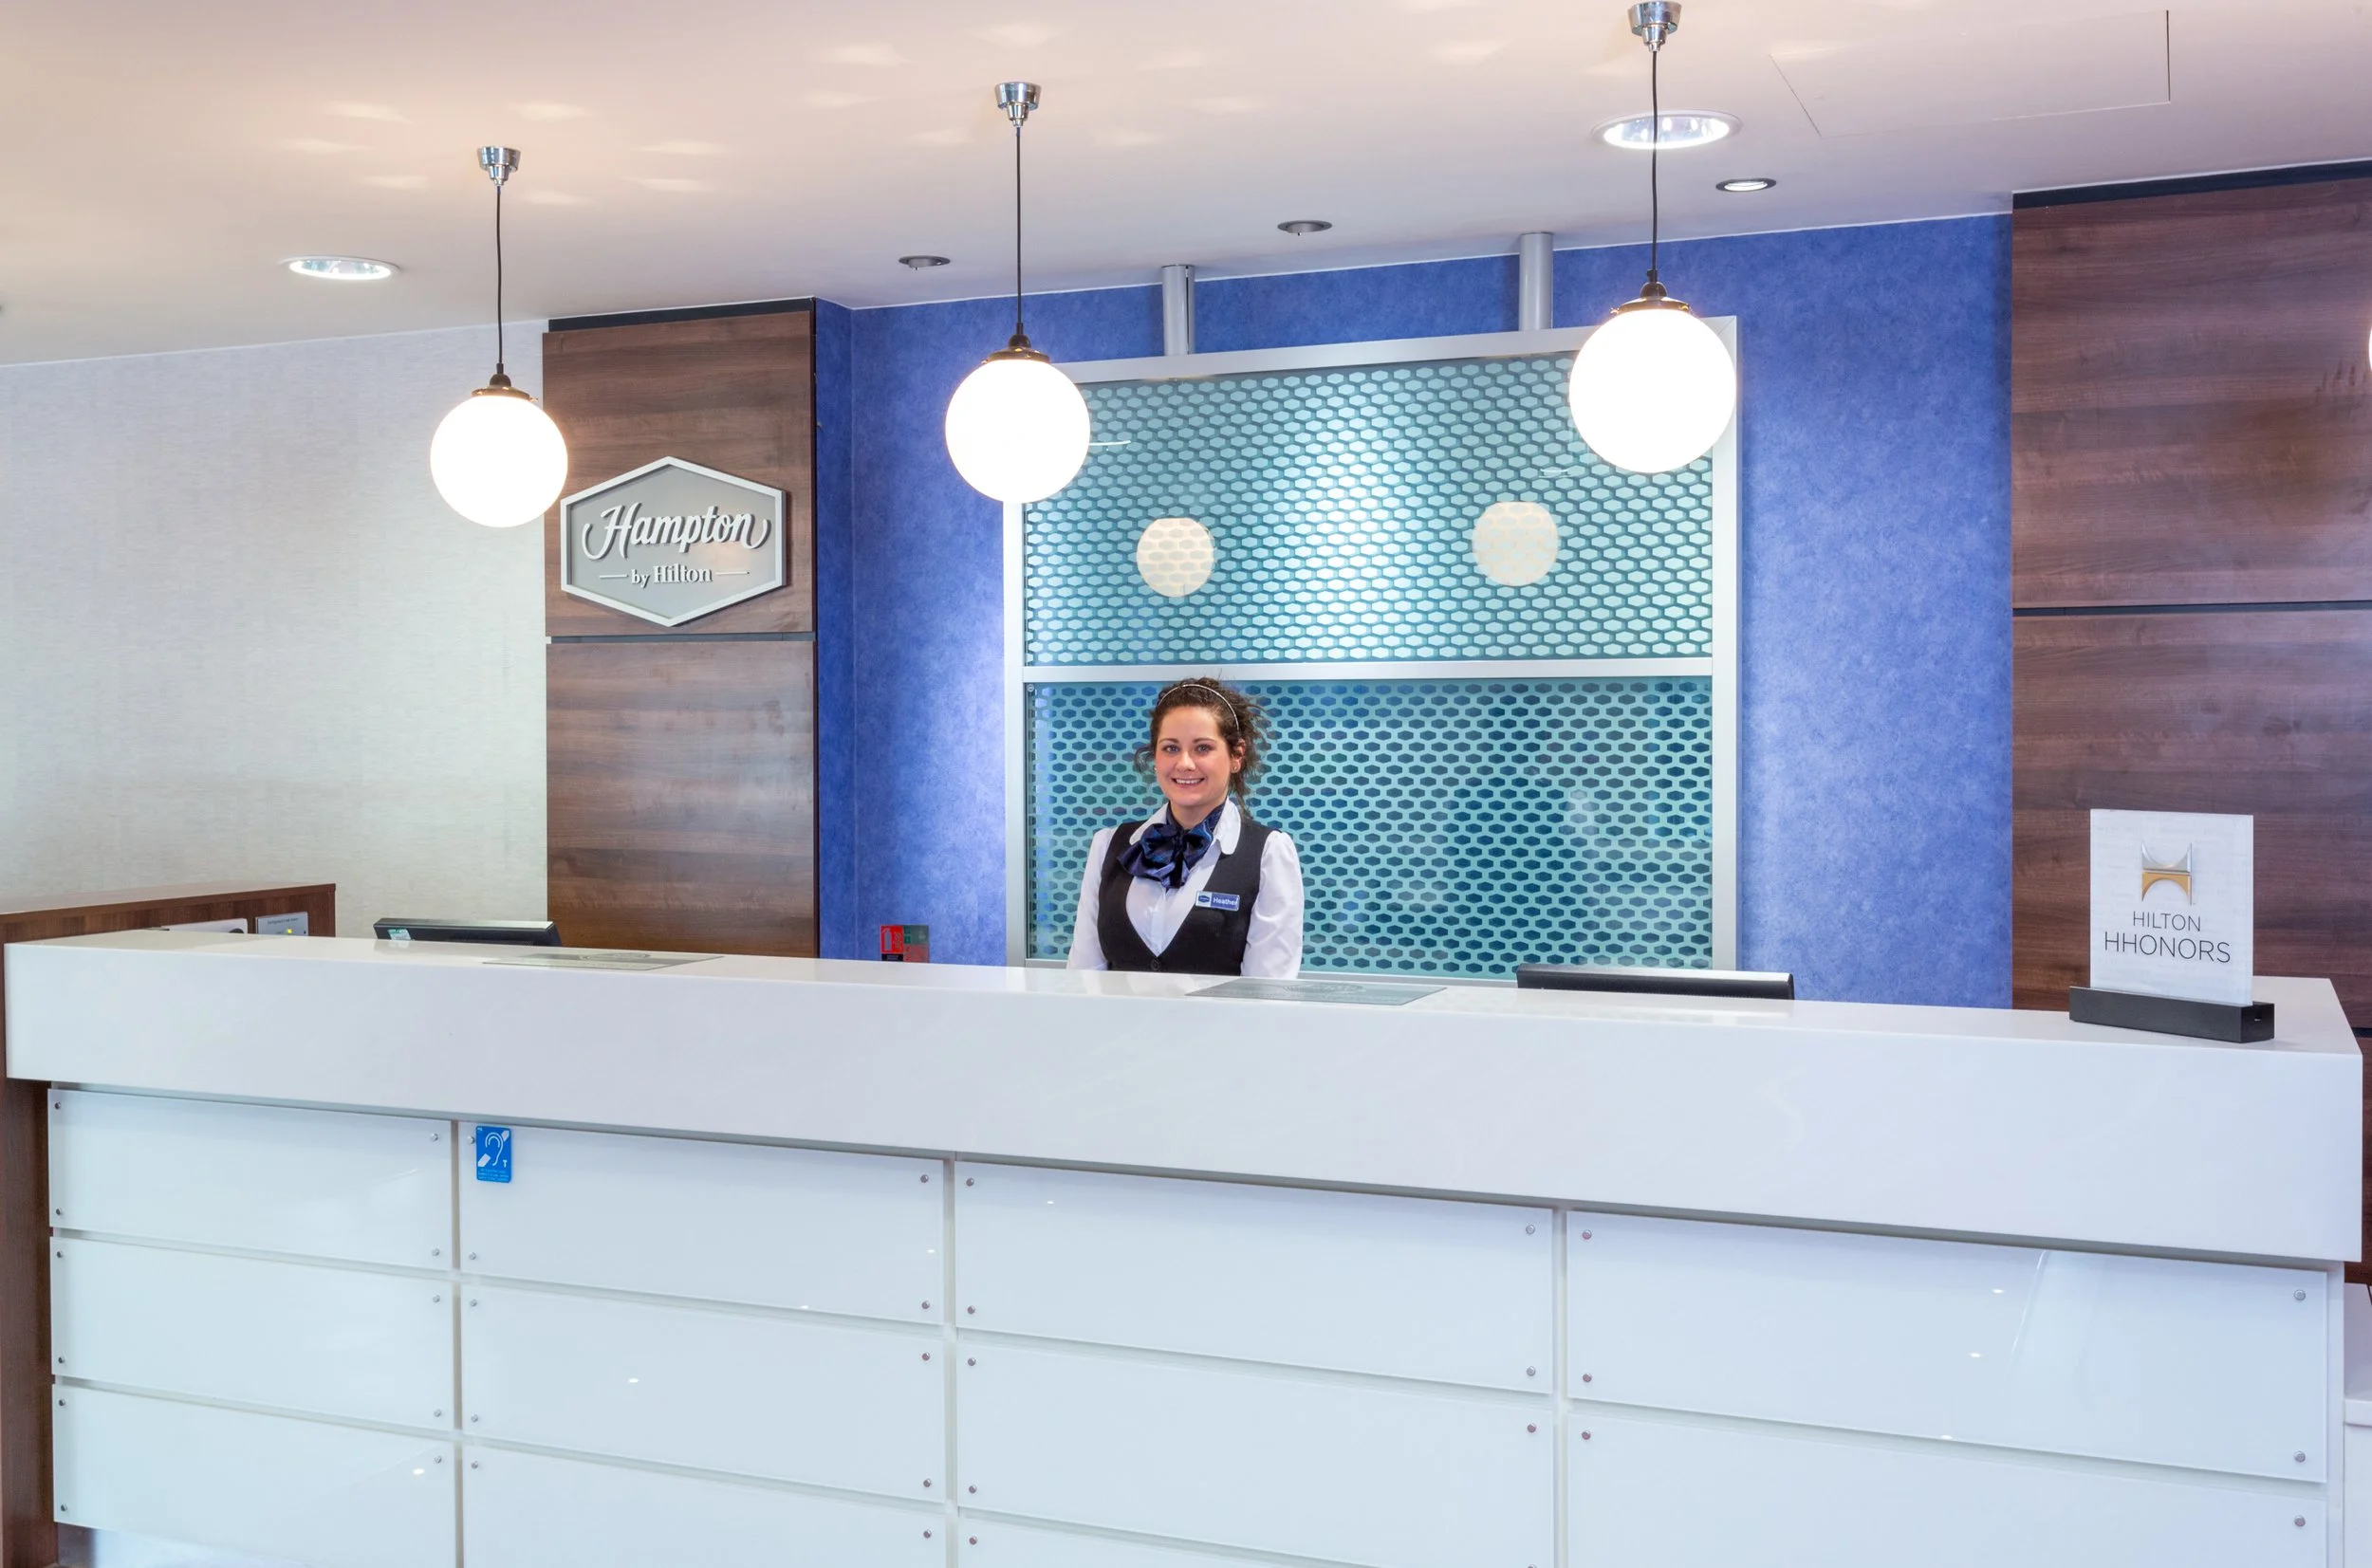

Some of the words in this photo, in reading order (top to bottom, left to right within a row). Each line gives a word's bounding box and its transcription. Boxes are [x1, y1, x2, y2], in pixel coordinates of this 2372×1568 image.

[581, 501, 769, 561] Hampton
[631, 569, 649, 588] by
[653, 563, 713, 584] Hilton
[2133, 911, 2201, 932] HILTON
[2104, 931, 2232, 964] HHONORS
